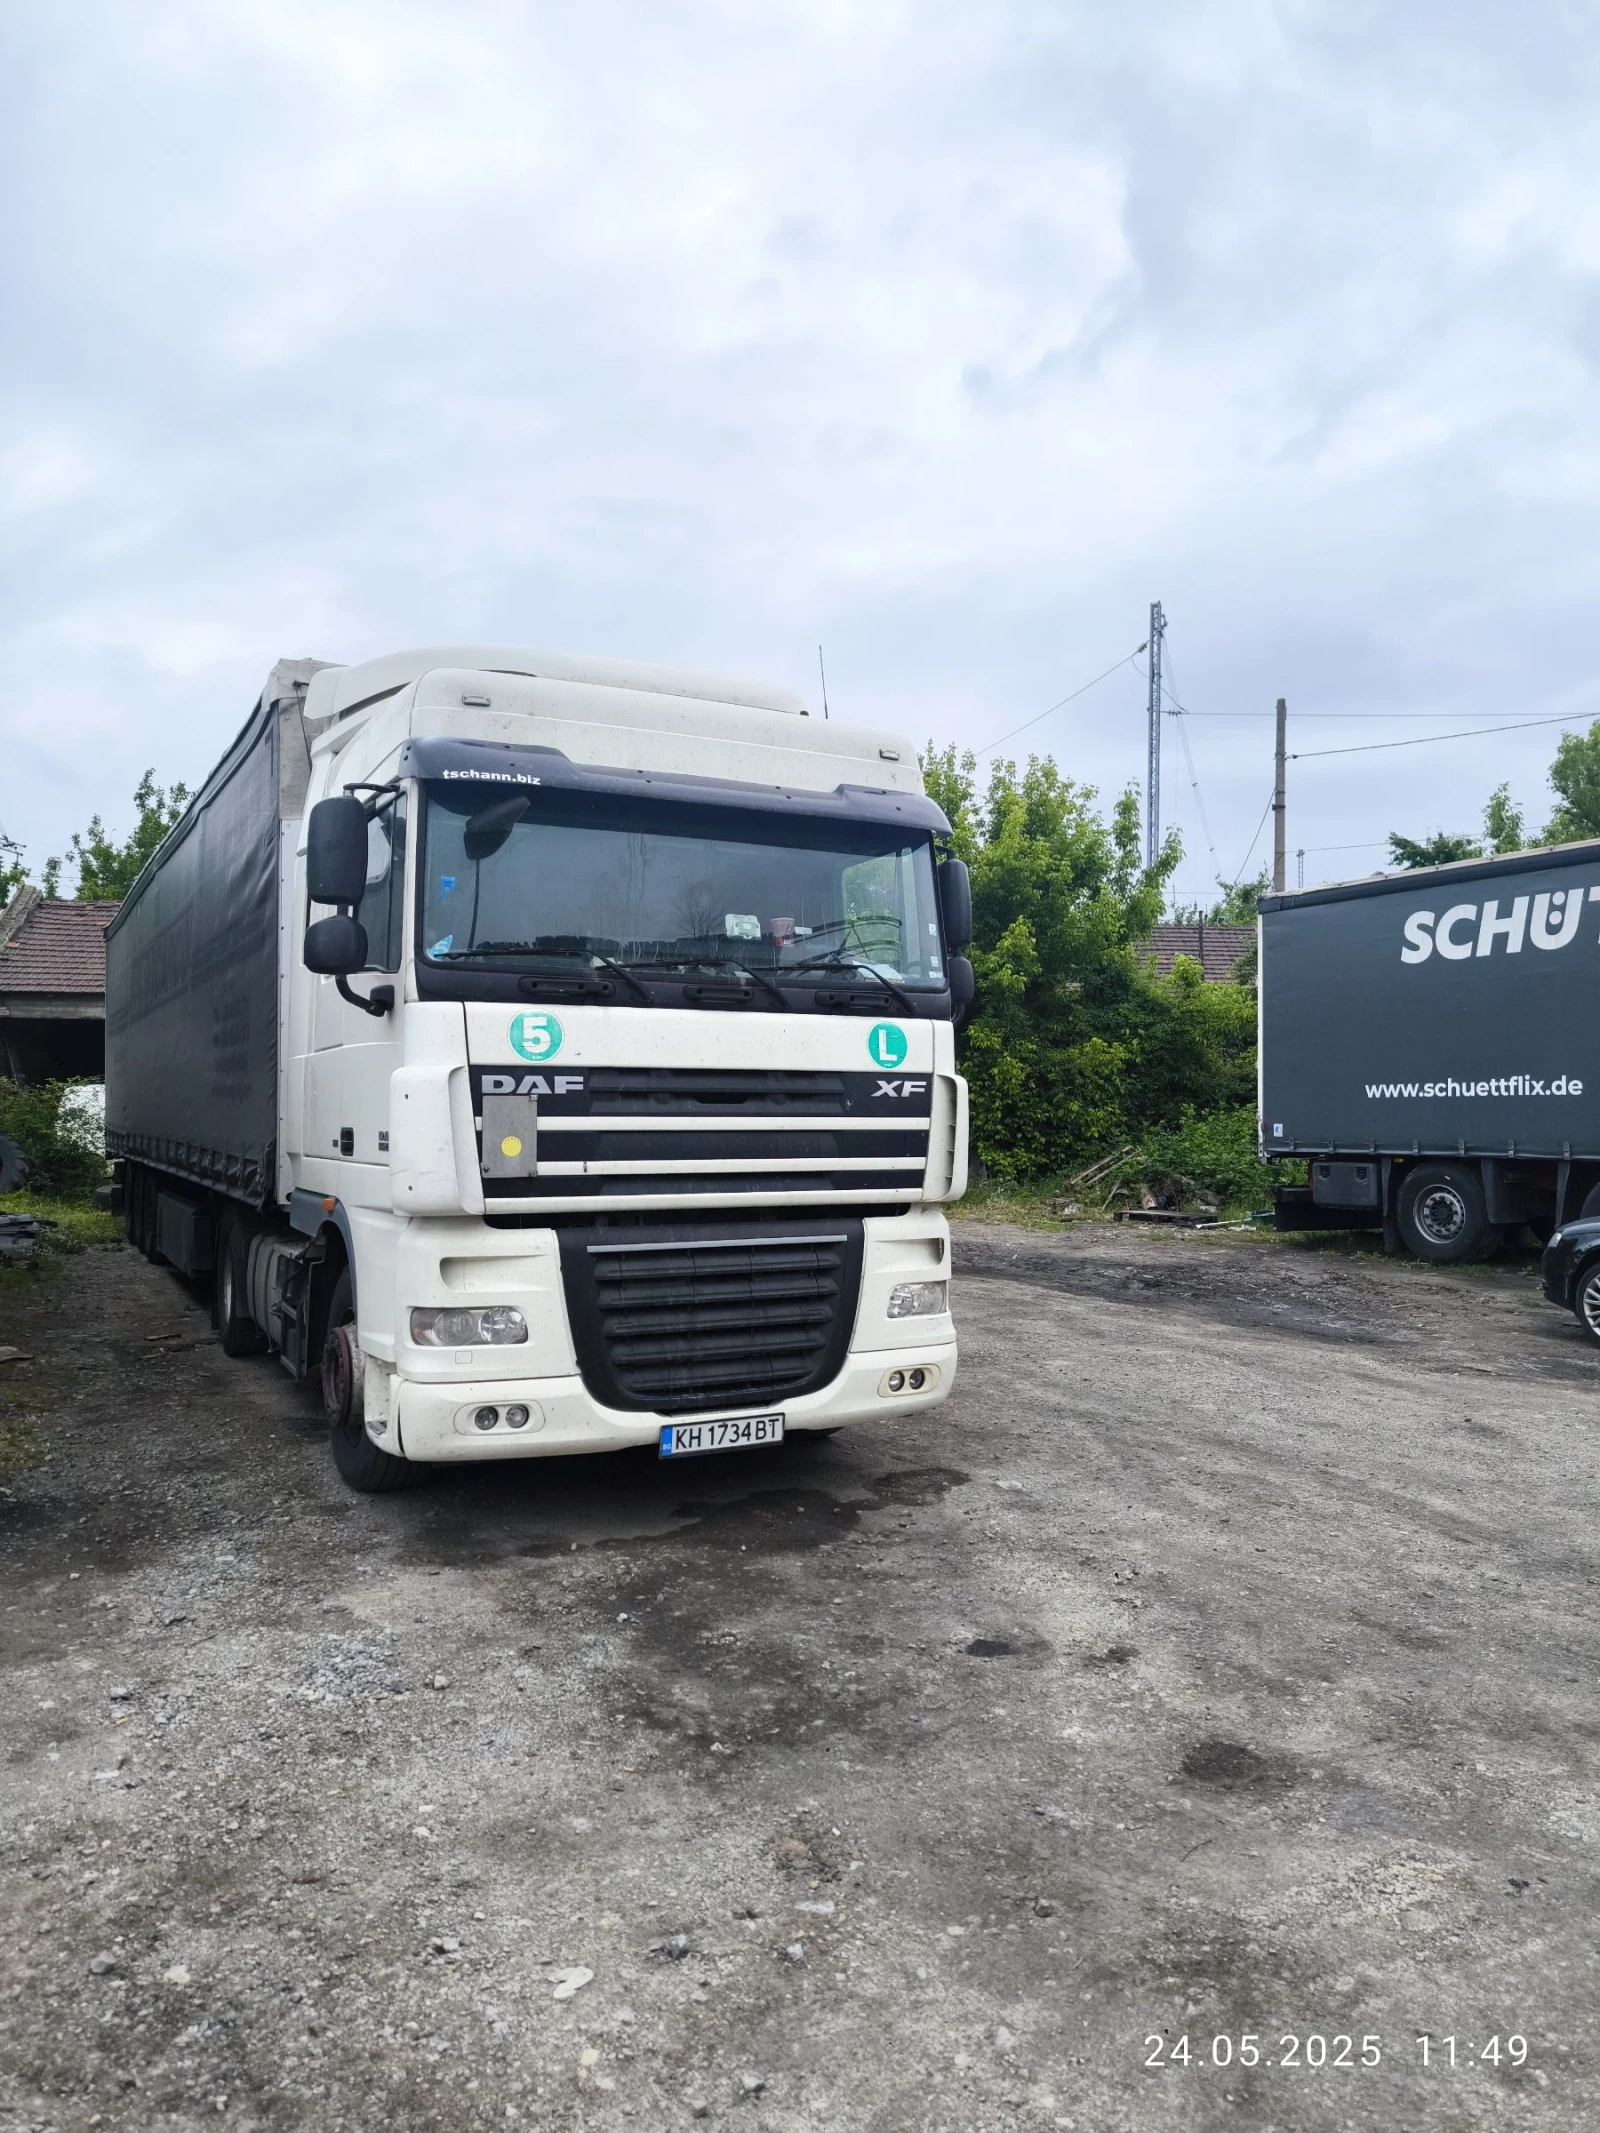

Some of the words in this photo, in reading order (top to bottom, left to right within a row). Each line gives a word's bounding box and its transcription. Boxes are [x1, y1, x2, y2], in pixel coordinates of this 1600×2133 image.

[443, 769, 541, 785] tschann.biz
[1400, 886, 1600, 964] SCHÜ
[522, 1016, 551, 1054] 5
[878, 1029, 897, 1061] L
[481, 1075, 584, 1094] DAF
[870, 1080, 927, 1097] XF
[1365, 1074, 1583, 1098] www.schuettflix.de
